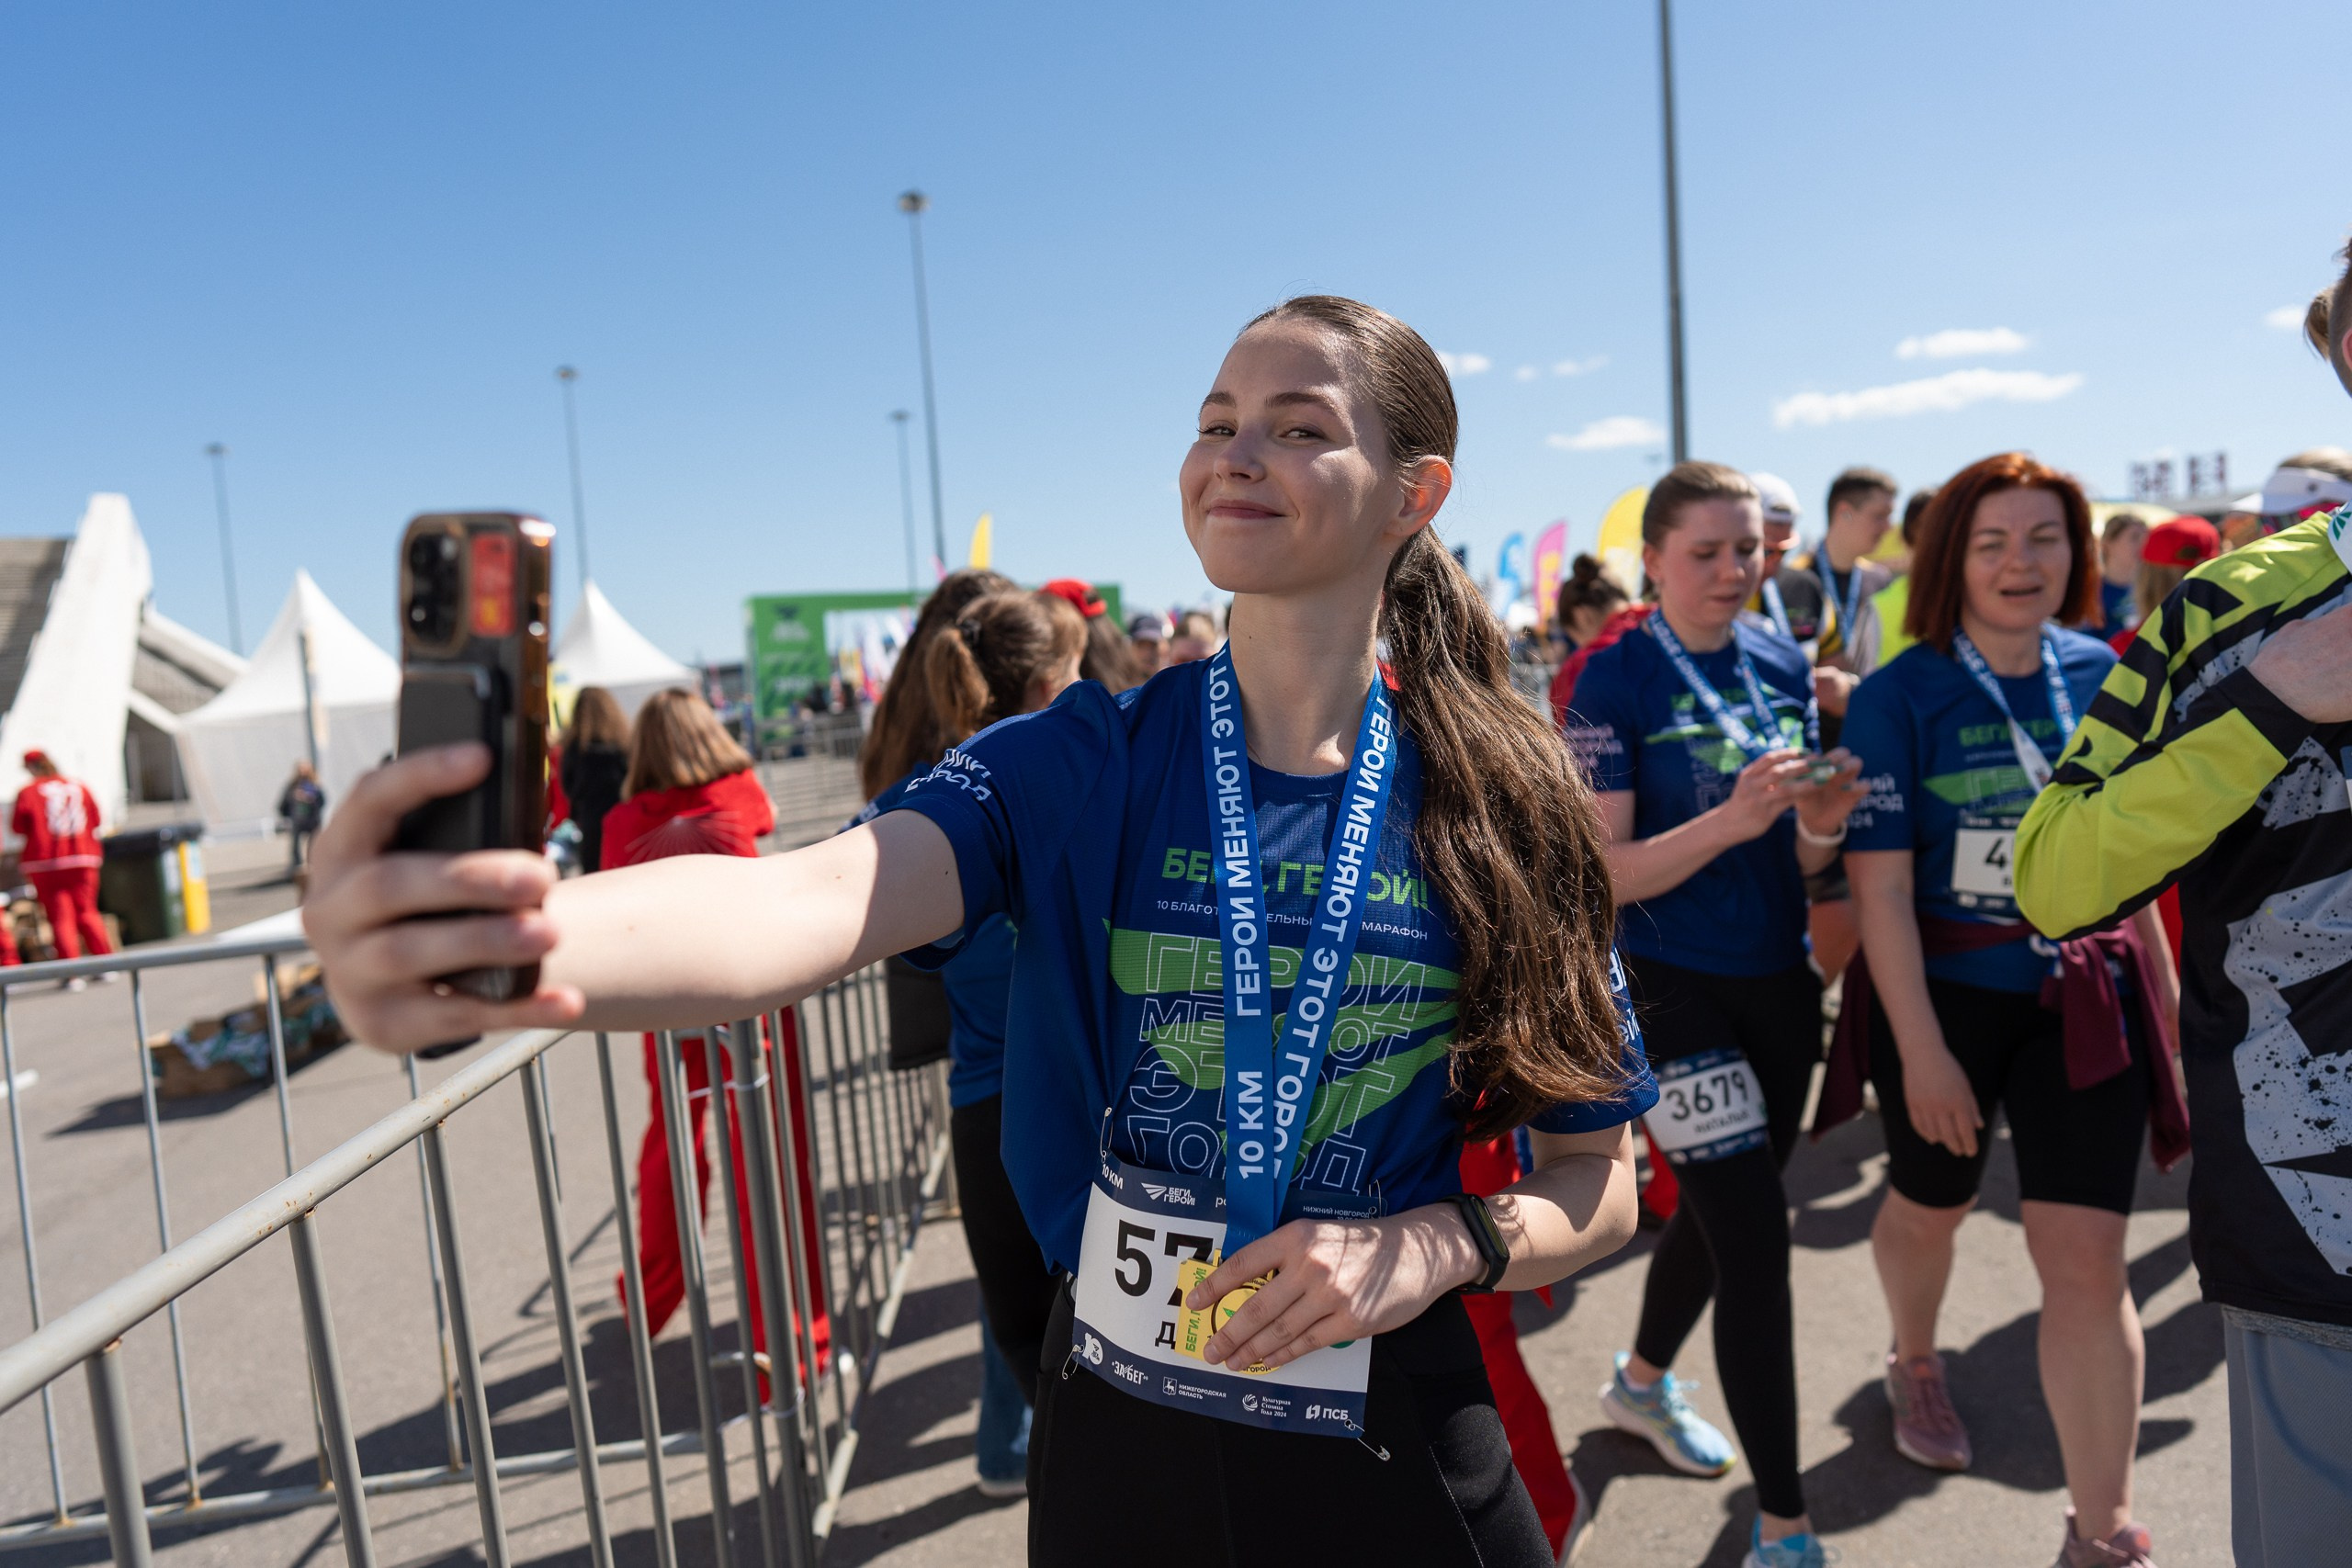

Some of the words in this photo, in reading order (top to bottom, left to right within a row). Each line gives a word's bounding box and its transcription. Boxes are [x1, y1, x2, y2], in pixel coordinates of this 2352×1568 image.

[1209, 665, 1235, 739] ЭТОТ
[1356, 696, 1393, 793] ГЕРОИ
[1214, 747, 1252, 888] МЕНЯЮТ
[1278, 860, 1429, 909] ГЕОЙ!
[1321, 794, 1375, 942] МЕНЯЮТ
[1156, 899, 1170, 910] 10
[1362, 921, 1428, 942] МАРАФОН
[1230, 897, 1261, 1016] ГЕРОИ
[1293, 947, 1339, 1048] ЭТОТ
[1238, 1071, 1264, 1130] КМ
[1666, 1068, 1748, 1121] 3679
[1273, 1052, 1311, 1179] ГОРО
[1102, 1164, 1109, 1179] 10
[1109, 1170, 1124, 1190] КМ
[1238, 1140, 1264, 1179] 10
[1163, 1193, 1195, 1206] ГЕРОЙ!
[1169, 1187, 1192, 1198] БЕГИ,
[1303, 1205, 1333, 1214] НИЖНИЙ
[1334, 1209, 1370, 1219] НОВГОРОД
[1185, 1317, 1202, 1353] БЕГИ,
[1178, 1390, 1204, 1400] ОБЛАСТЬ
[1179, 1383, 1227, 1399] НИЖЕГОРОДСКАЯ
[1261, 1396, 1292, 1406] Культурная
[1261, 1404, 1283, 1412] Столица
[1323, 1407, 1349, 1421] ПСБ
